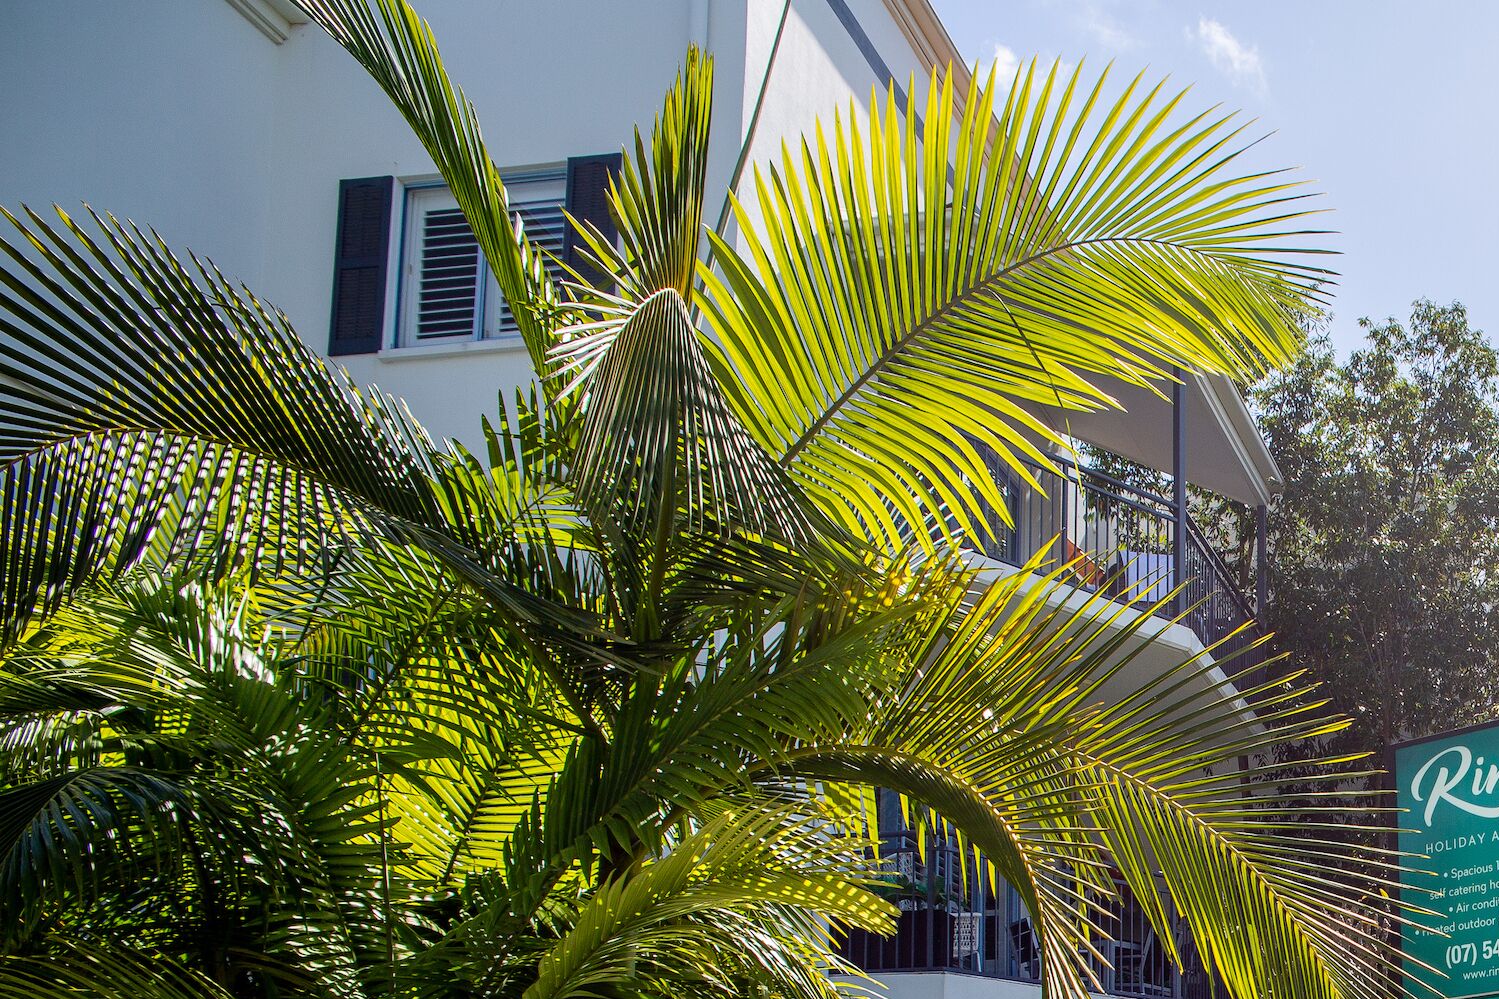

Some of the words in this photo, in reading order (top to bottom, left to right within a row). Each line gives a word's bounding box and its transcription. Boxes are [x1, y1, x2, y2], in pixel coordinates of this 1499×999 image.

[1425, 832, 1486, 855] HOLIDAY
[1450, 863, 1493, 881] Spacious
[1496, 860, 1499, 871] 1
[1449, 883, 1487, 897] catering
[1456, 901, 1469, 913] Air
[1458, 916, 1496, 932] outdoor
[1445, 943, 1477, 969] (07)
